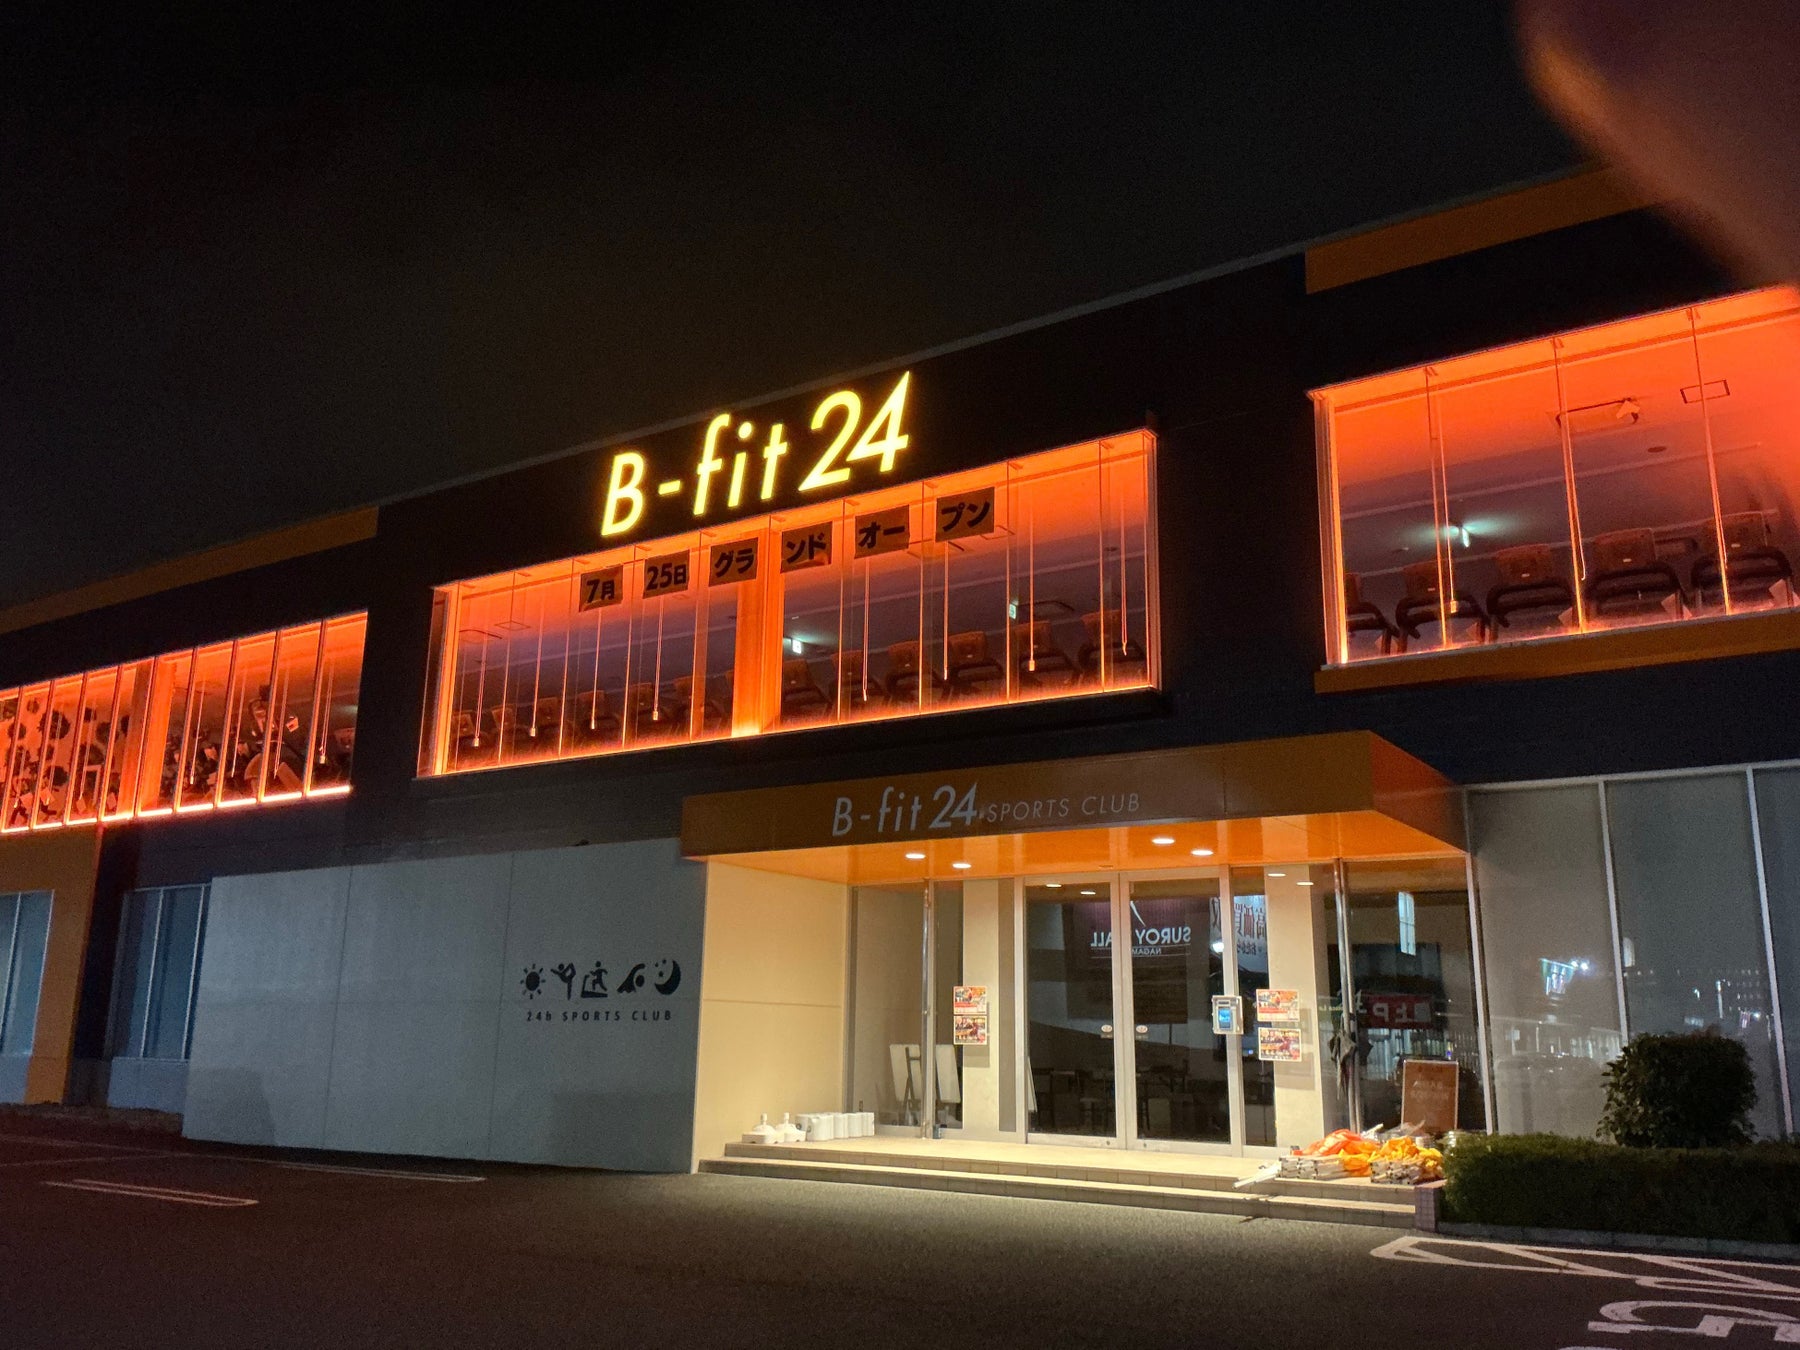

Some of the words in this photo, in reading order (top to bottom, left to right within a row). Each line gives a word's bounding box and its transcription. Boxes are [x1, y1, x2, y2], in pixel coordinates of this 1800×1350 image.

[601, 413, 788, 536] B-fit
[798, 371, 910, 492] 24
[586, 578, 616, 602] 7月
[646, 561, 688, 591] 25日
[714, 547, 756, 579] グラ
[786, 530, 827, 562] ンド
[857, 521, 906, 548] オー
[941, 500, 992, 532] プン
[832, 785, 922, 837] B-fit
[929, 781, 978, 829] 24
[986, 797, 1070, 824] SPORTS
[1081, 792, 1140, 817] CLUB
[526, 1010, 552, 1022] 24h
[562, 1010, 621, 1022] SPORTS
[631, 1009, 672, 1021] CLUB
